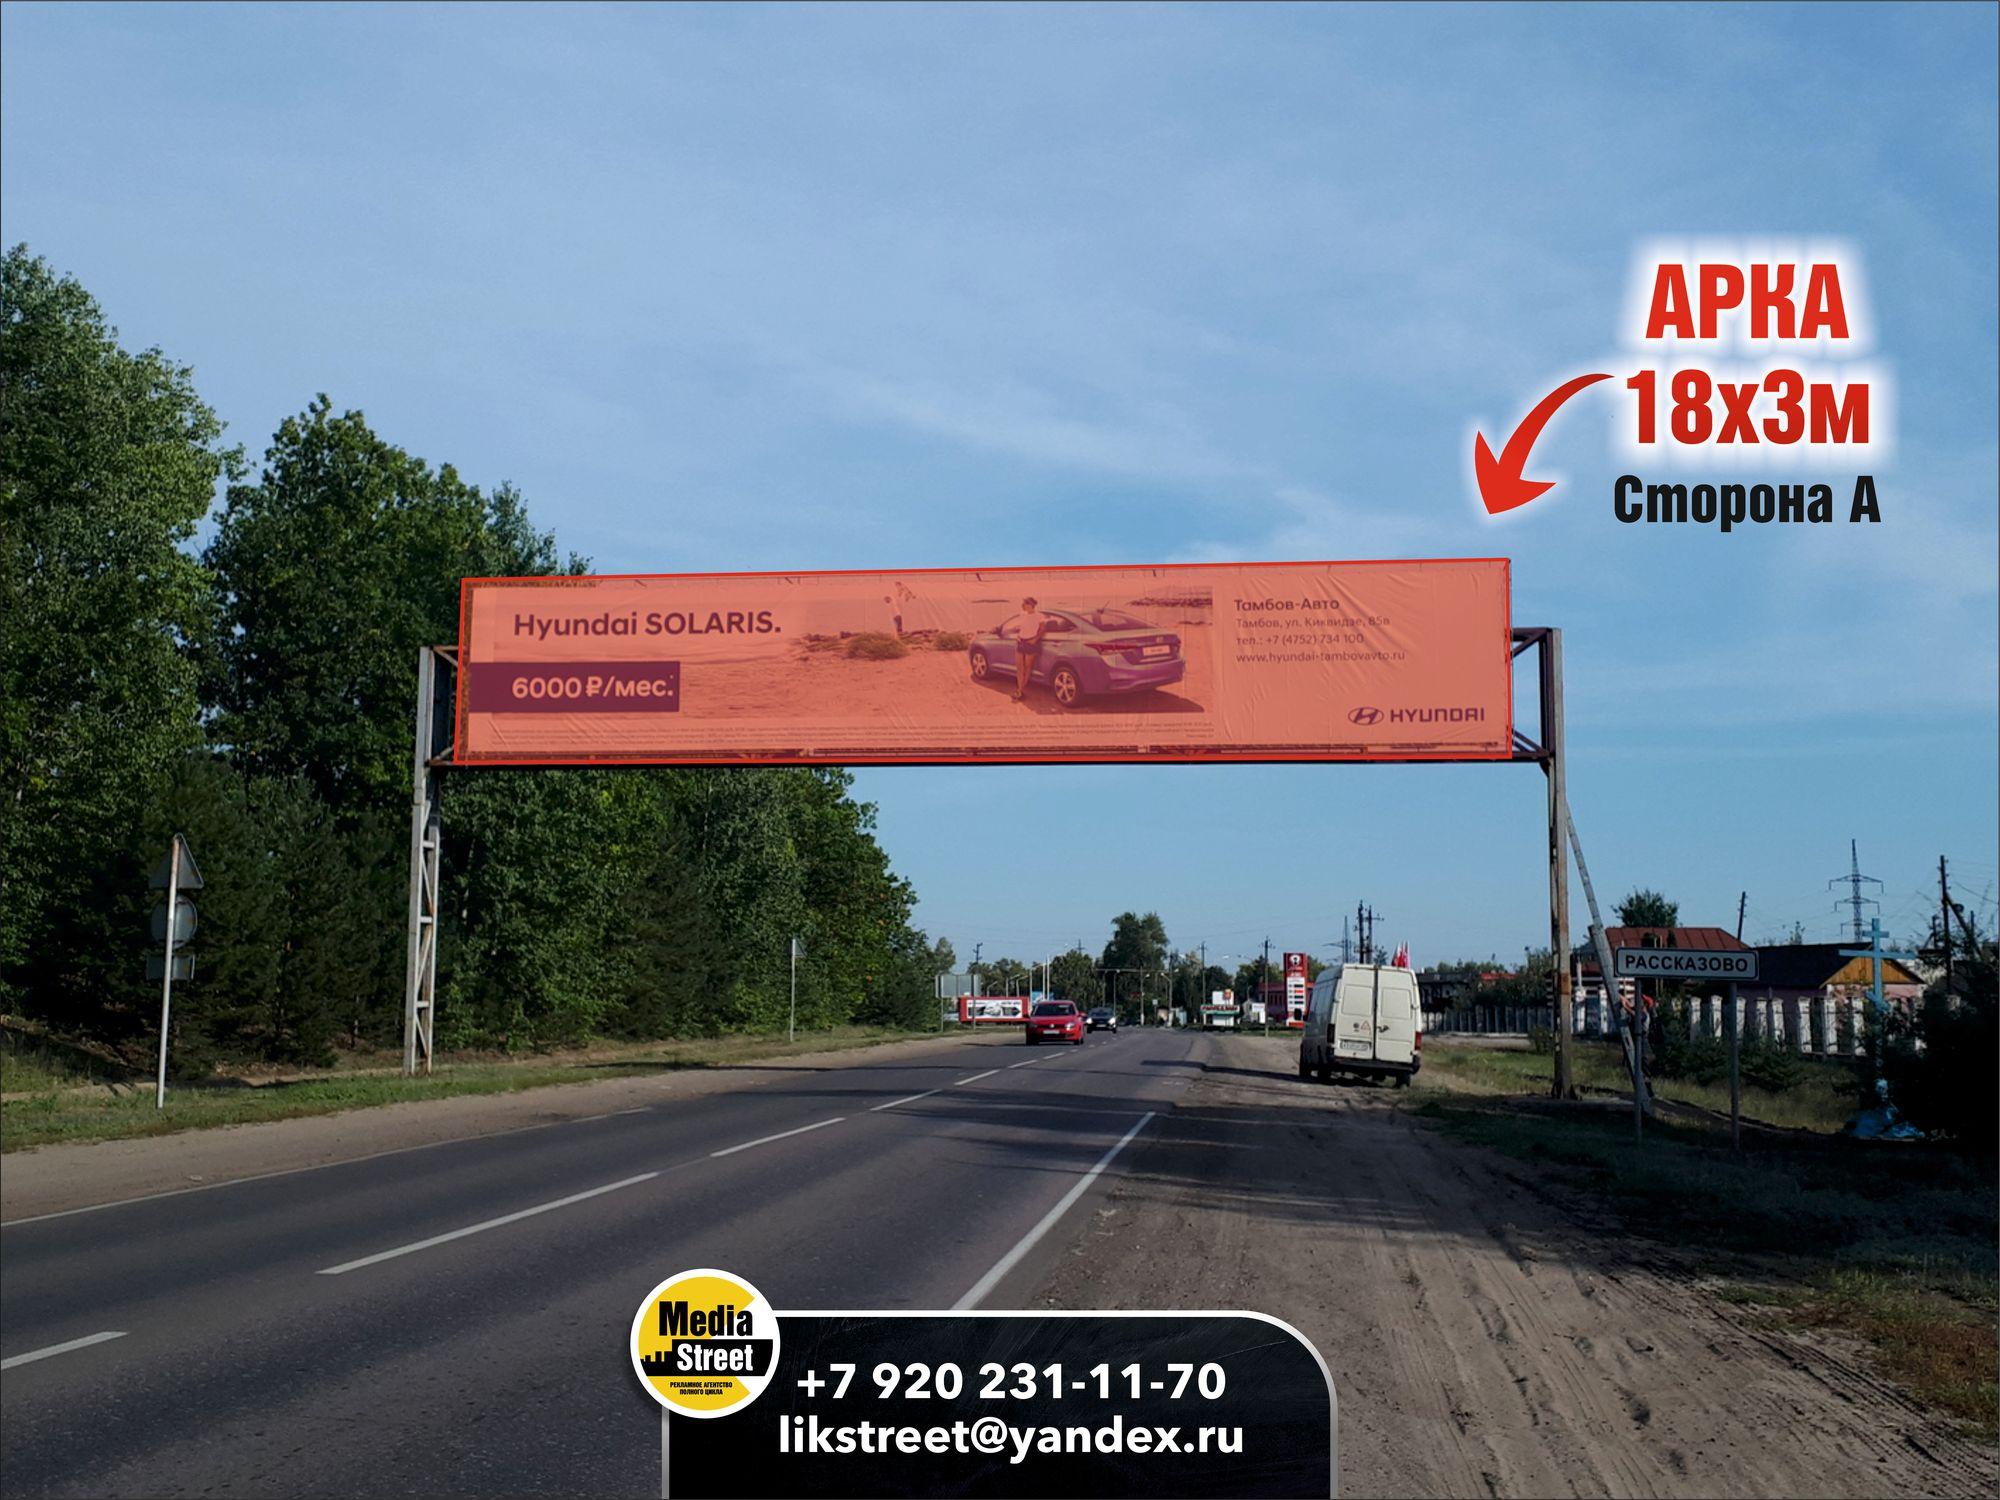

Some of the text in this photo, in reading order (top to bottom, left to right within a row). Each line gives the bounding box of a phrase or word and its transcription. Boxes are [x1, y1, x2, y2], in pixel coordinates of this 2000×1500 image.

[1234, 598, 1340, 612] Тамбов-Авто
[513, 610, 783, 641] Hyundai SOLARIS.
[1236, 617, 1283, 629] Тамбов,
[1320, 634, 1340, 645] 734
[1236, 650, 1406, 664] www.hyundai-tambovavto.ru
[1390, 707, 1485, 722] HYUNDAI
[1624, 954, 1749, 973] РАССКАЗОВО
